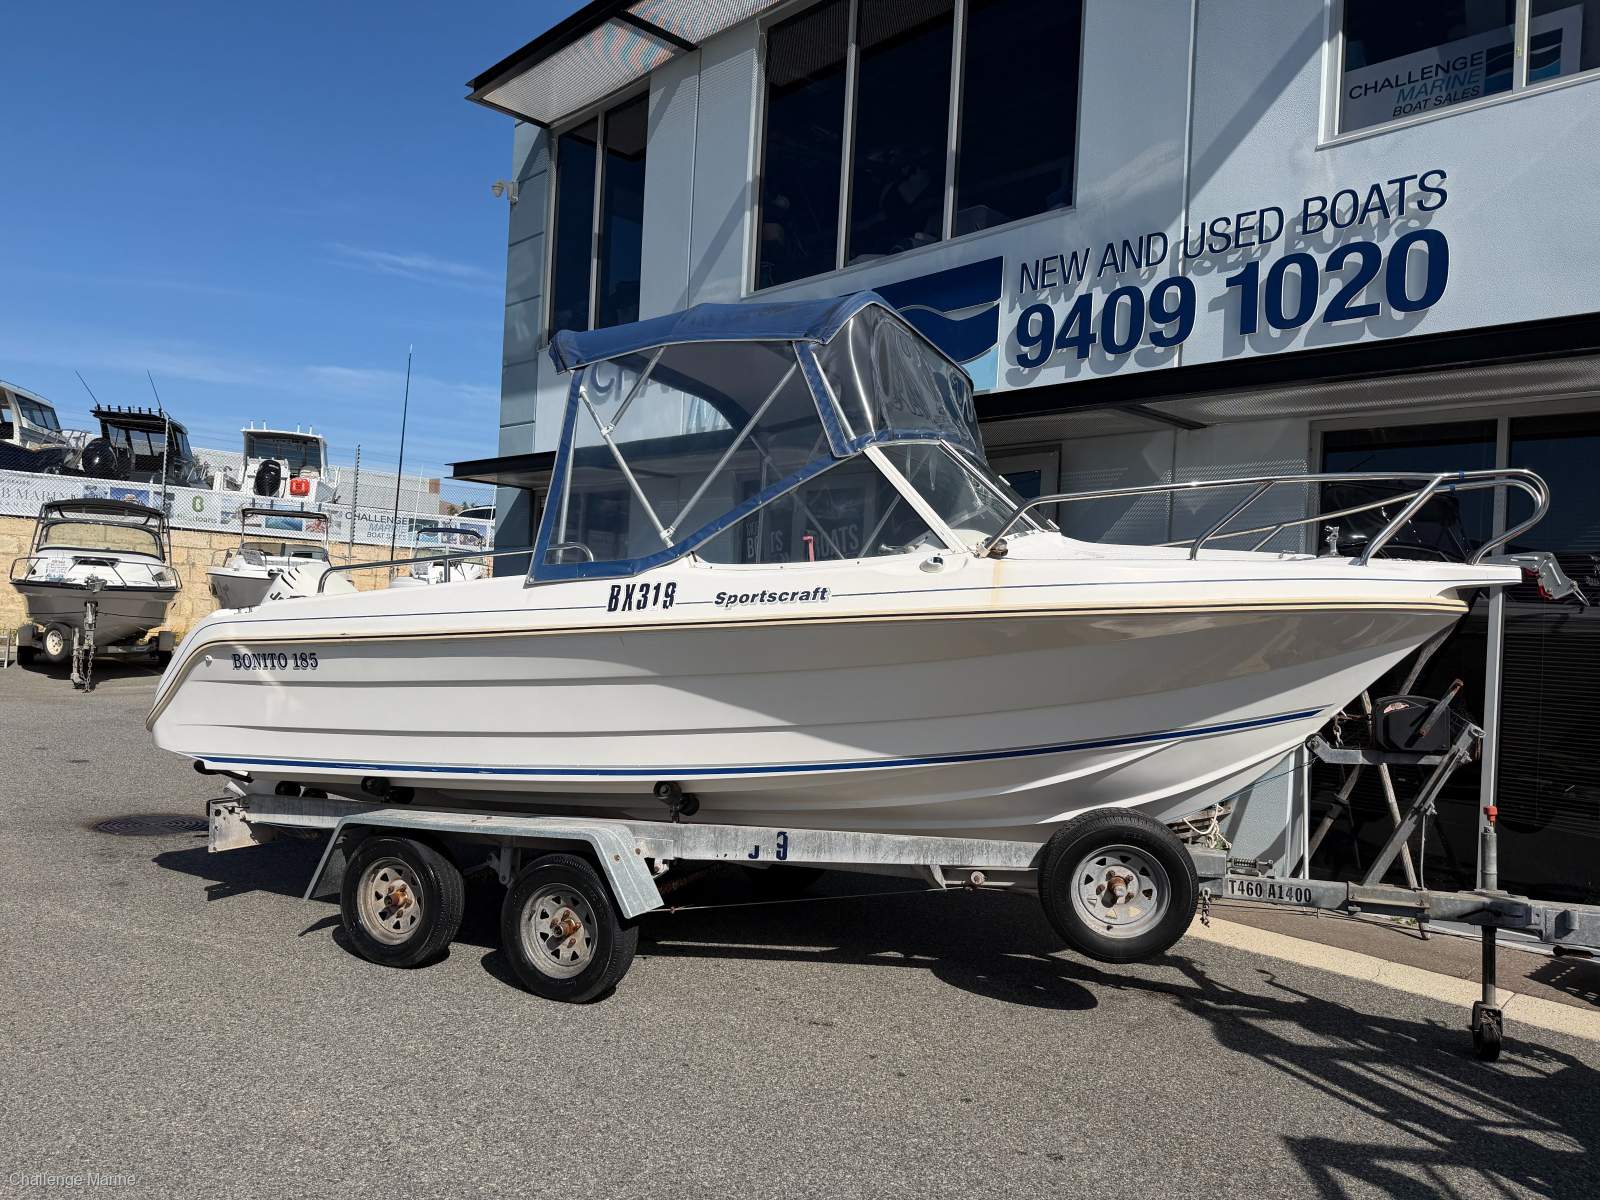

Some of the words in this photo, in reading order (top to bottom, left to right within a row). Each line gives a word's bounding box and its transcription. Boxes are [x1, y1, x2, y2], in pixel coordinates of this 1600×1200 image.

[1349, 50, 1484, 99] CHALLENGE
[1396, 67, 1483, 103] MARINE
[1393, 98, 1431, 119] BOAT
[1433, 85, 1481, 107] SALES
[1019, 247, 1091, 294] NEW
[1097, 231, 1168, 277] AND
[1183, 206, 1284, 259] USED
[1301, 169, 1448, 235] BOATS
[1016, 276, 1197, 369] 9409
[1226, 228, 1449, 336] 1020
[345, 511, 408, 525] CHALLENGE
[607, 582, 677, 612] BX319
[714, 587, 829, 607] Sportscraft
[232, 653, 288, 670] BONITO
[293, 652, 319, 670] 185
[1229, 880, 1263, 898] T460
[1267, 883, 1312, 903] A1400
